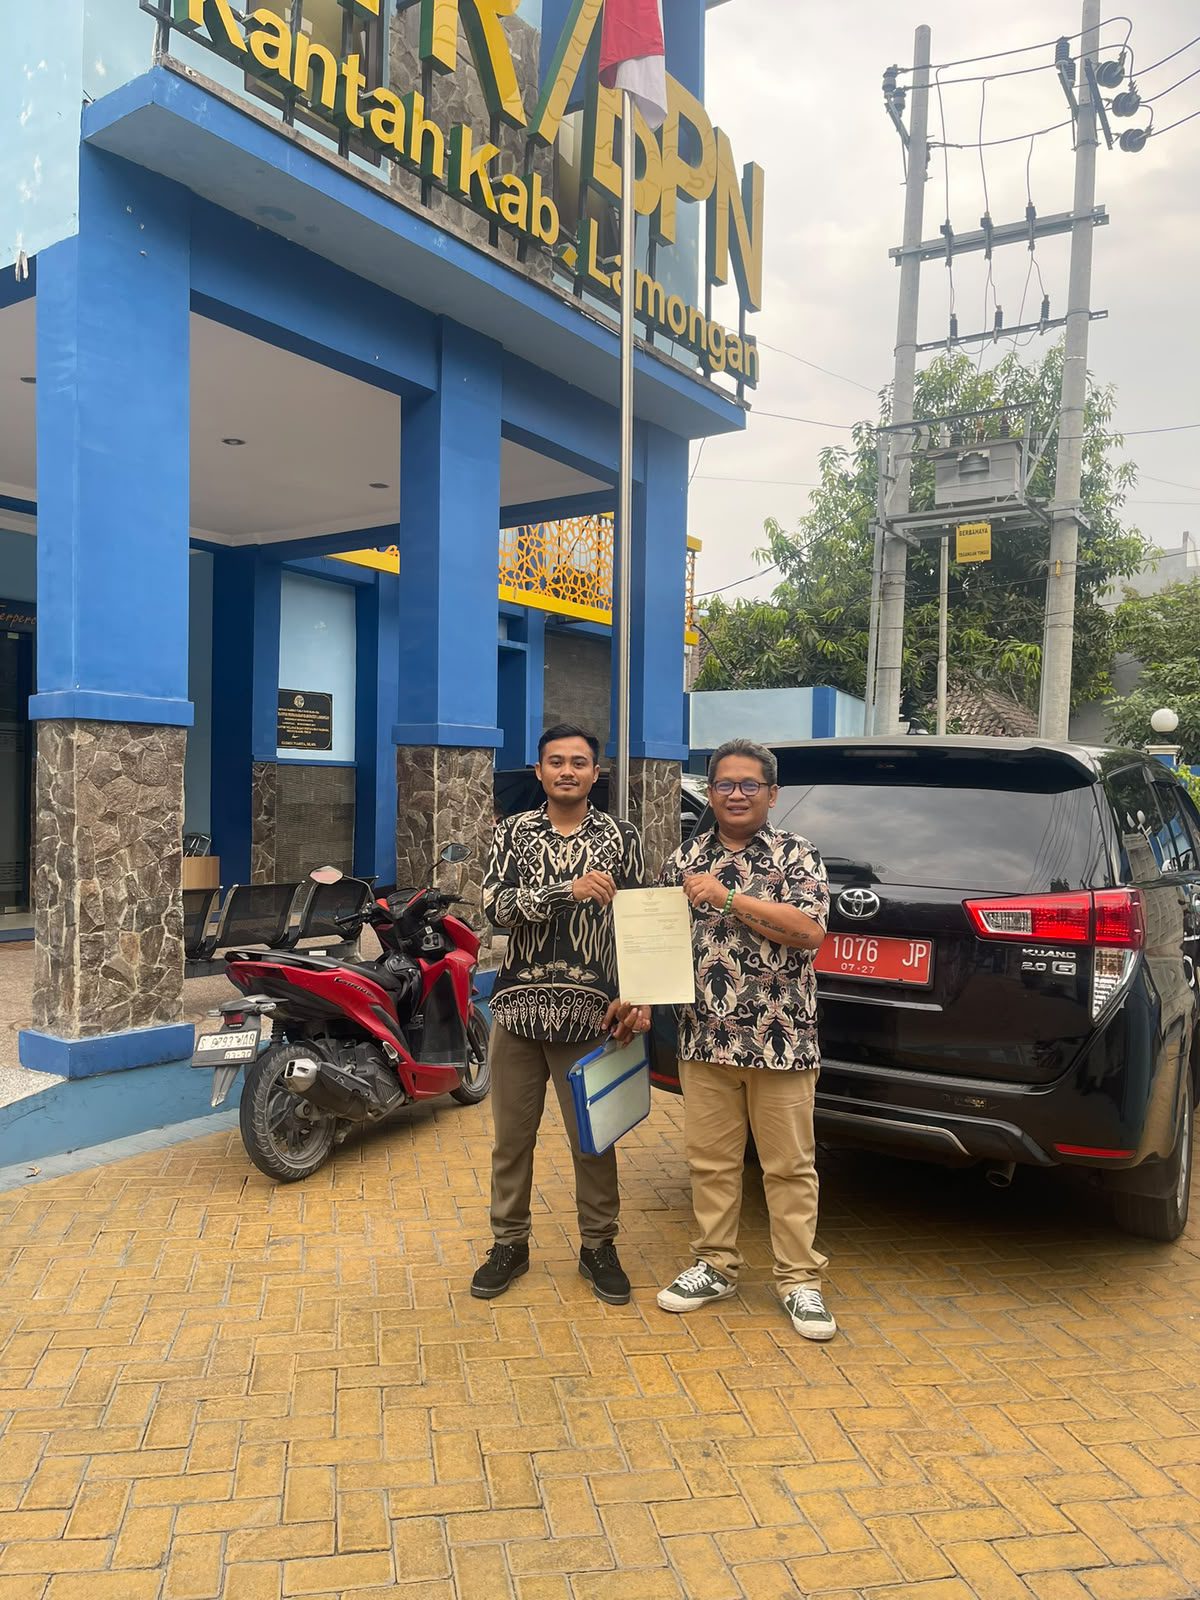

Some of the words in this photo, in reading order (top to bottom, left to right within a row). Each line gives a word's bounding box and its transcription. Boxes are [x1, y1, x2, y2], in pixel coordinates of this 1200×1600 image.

[833, 936, 879, 963] 1076
[902, 943, 927, 968] JP
[1053, 961, 1076, 975] G
